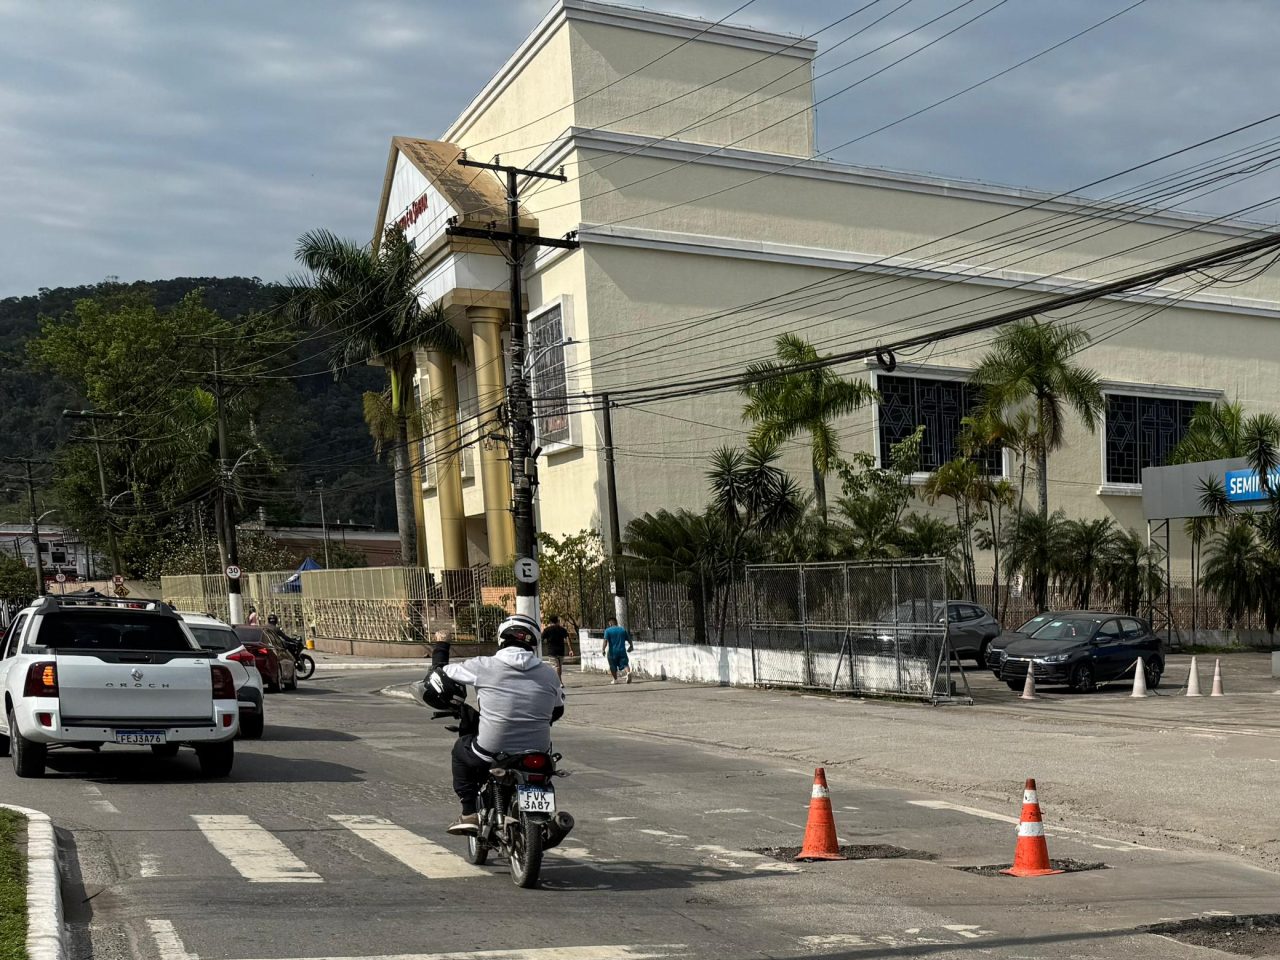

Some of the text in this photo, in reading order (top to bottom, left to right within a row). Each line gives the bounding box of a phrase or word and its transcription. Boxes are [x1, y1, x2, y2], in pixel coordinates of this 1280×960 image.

[522, 562, 532, 578] E
[120, 734, 161, 743] FEJ3A76
[526, 791, 547, 802] FVK
[524, 800, 551, 811] 3A87
